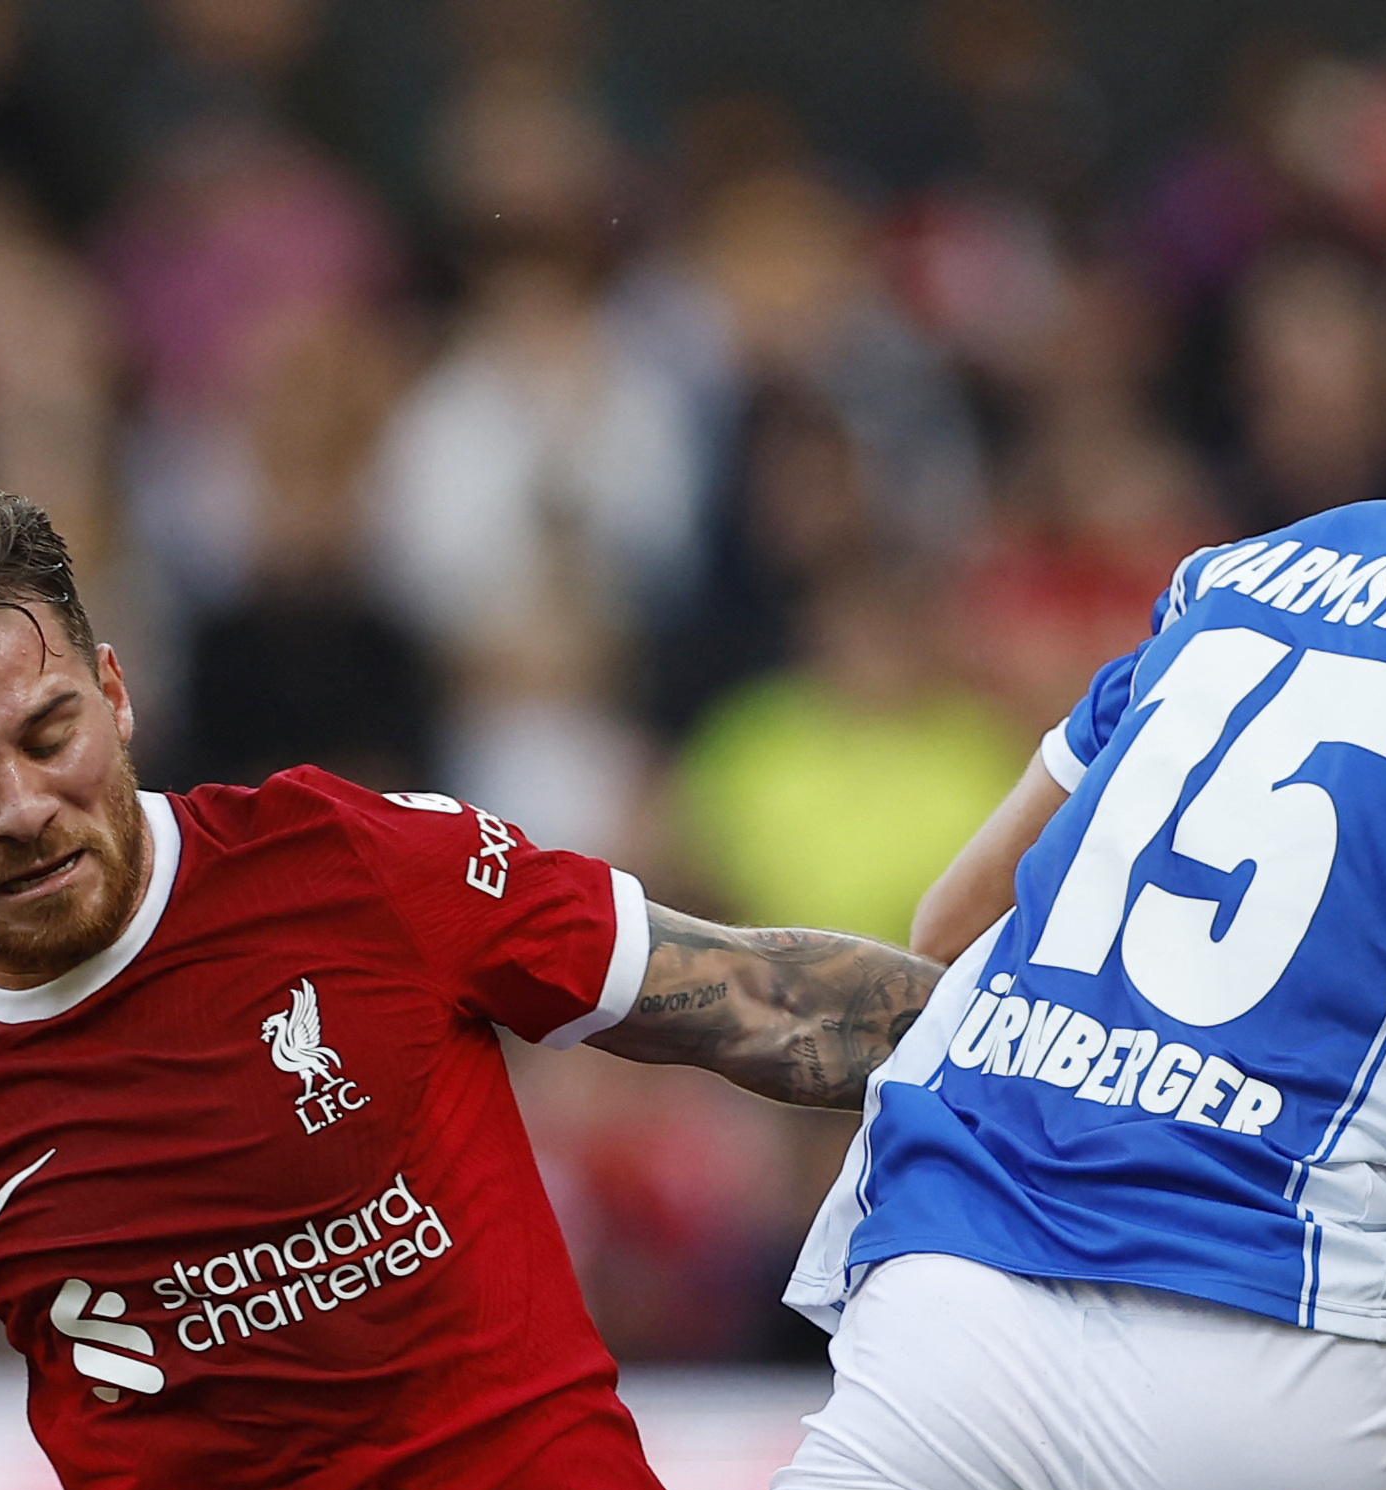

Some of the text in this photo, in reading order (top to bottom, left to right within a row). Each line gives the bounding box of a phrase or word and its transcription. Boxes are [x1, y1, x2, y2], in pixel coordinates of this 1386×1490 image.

[294, 1081, 371, 1135] L.F.C.
[947, 972, 1283, 1136] ÜRNBERGER
[153, 1172, 423, 1310] standard
[177, 1205, 453, 1352] chartered
